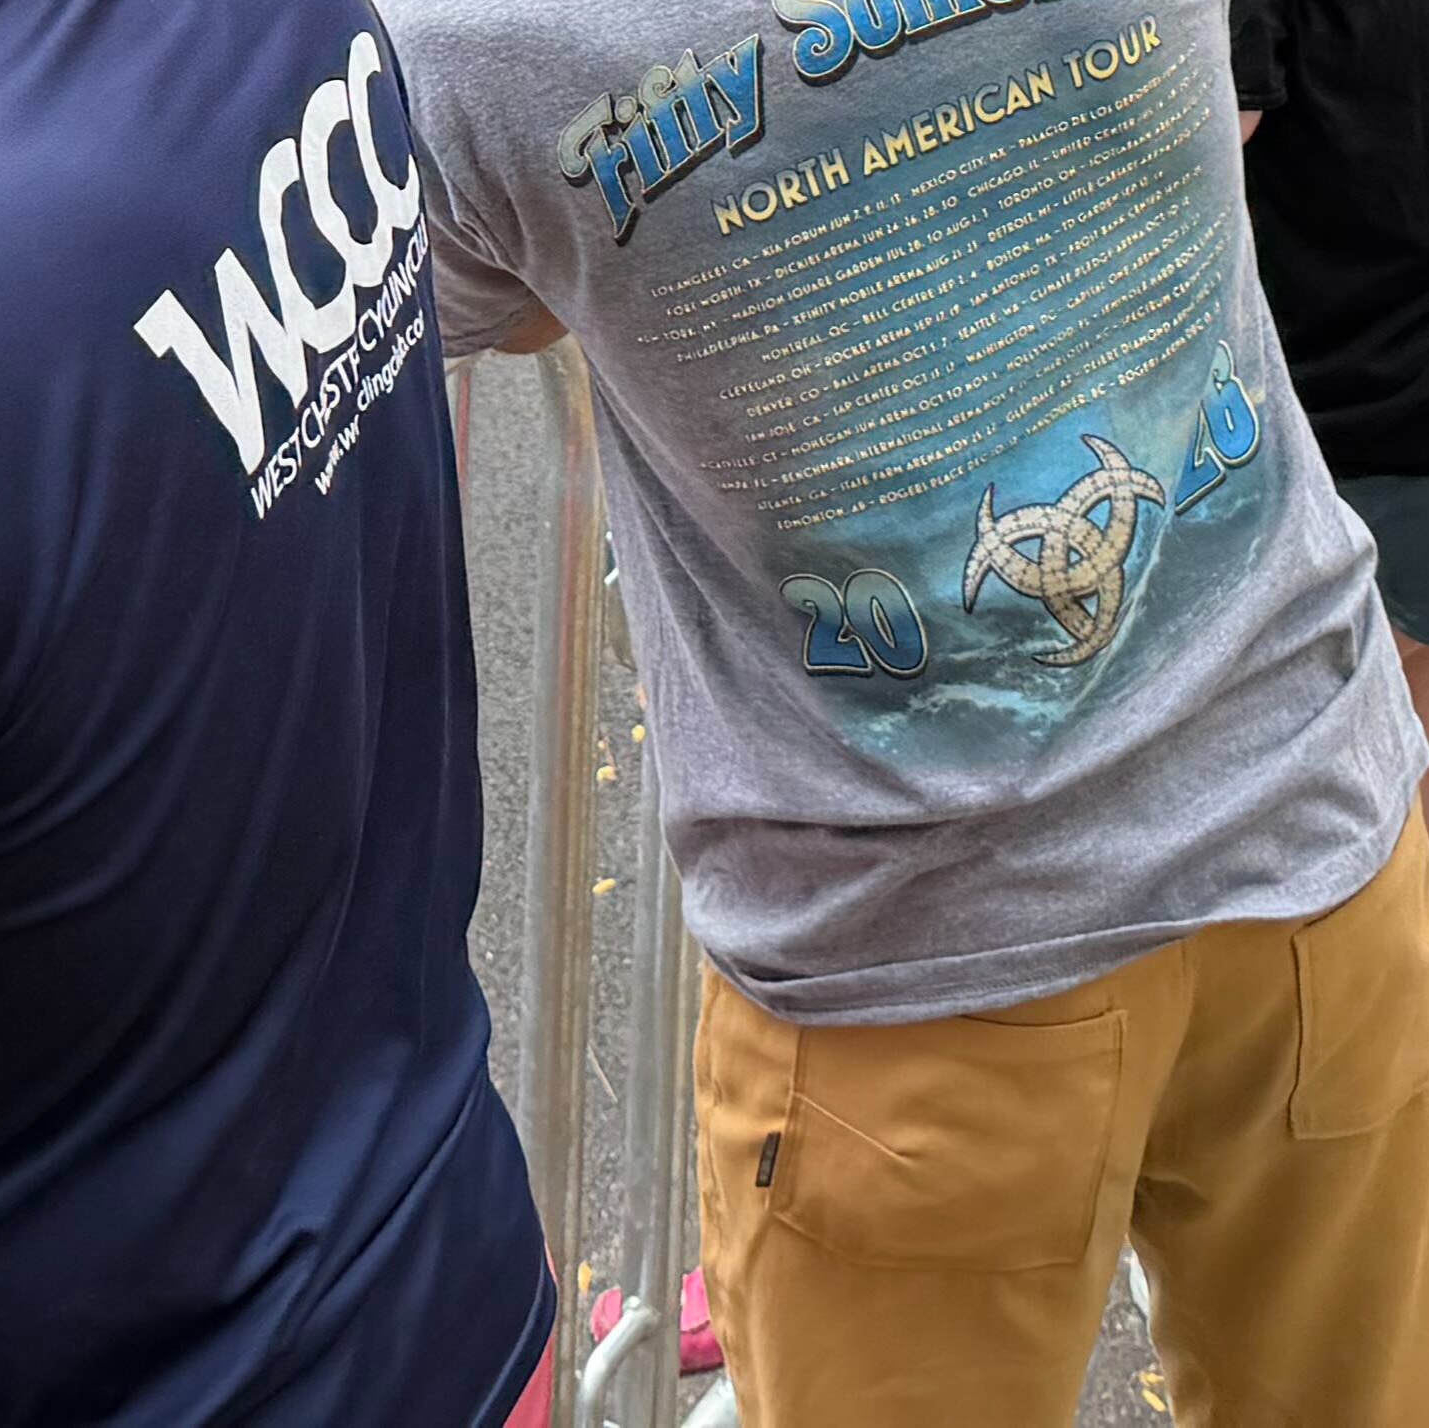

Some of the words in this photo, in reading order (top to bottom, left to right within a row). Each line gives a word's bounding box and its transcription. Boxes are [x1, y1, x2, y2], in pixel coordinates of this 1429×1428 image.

[557, 33, 762, 242] Fifty
[710, 148, 851, 236] NORTH
[863, 63, 1055, 176] AMERICAN
[1062, 12, 1162, 89] TOUR
[731, 257, 750, 269] CA
[761, 243, 783, 256] KIA
[783, 224, 827, 248] FORUM
[910, 168, 957, 196] MEXICO
[988, 146, 1006, 160] MX
[1017, 120, 1068, 148] PALACIO
[1070, 112, 1086, 126] DE
[786, 275, 832, 300] SQUARE
[834, 255, 883, 281] GARDEN
[885, 246, 906, 261] JUL
[945, 216, 971, 236] AUG
[823, 238, 861, 259] ARENA
[861, 226, 884, 244] JUN
[827, 321, 850, 337] QC
[861, 307, 889, 324] BELL
[891, 287, 935, 312] CENTRE
[1034, 232, 1052, 245] MA
[763, 323, 780, 335] PA
[791, 299, 835, 325] XFINITY
[838, 280, 883, 306] MOBILE
[886, 267, 924, 288] ARENA
[925, 253, 949, 272] AUG
[790, 363, 811, 379] OH
[823, 339, 871, 366] ROCKET
[875, 326, 911, 347] ARENA
[798, 387, 820, 402] CO
[832, 372, 860, 389] BALL
[862, 357, 900, 377] ARENA
[901, 344, 928, 362] OCT
[1001, 302, 1019, 315] WA
[790, 427, 852, 455] MOHEGAN
[879, 406, 917, 425] ARENA
[917, 393, 944, 411] OCT
[801, 414, 821, 426] CA
[854, 383, 899, 406] CENTER
[901, 372, 927, 390] OCT
[854, 422, 943, 460] INTERNATIONAL
[946, 406, 982, 427] ARENA
[250, 426, 303, 520] WEST
[851, 500, 866, 512] AB
[878, 481, 928, 504] ROGERS
[929, 465, 964, 488] PLACE
[1090, 381, 1106, 398] BC
[871, 464, 903, 480] FARM
[906, 450, 944, 470] ARENA
[779, 567, 928, 679] 20
